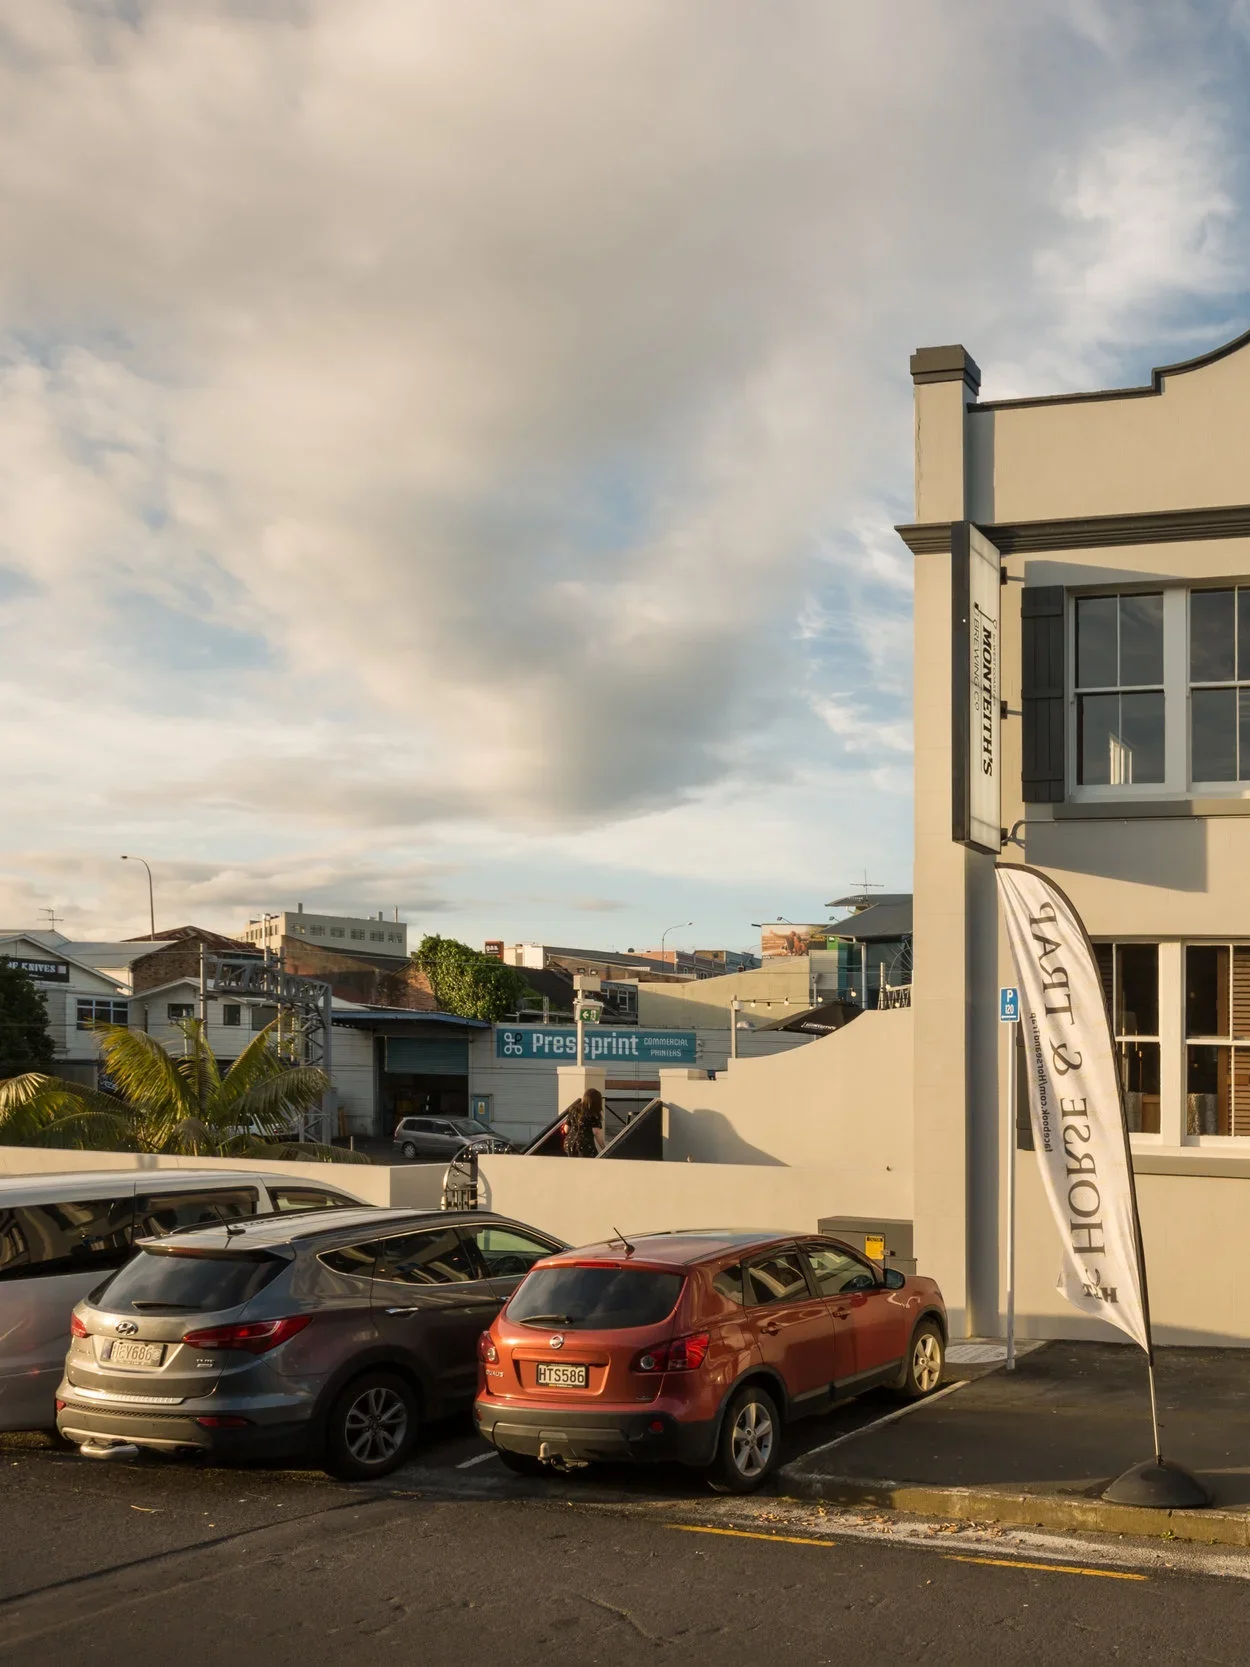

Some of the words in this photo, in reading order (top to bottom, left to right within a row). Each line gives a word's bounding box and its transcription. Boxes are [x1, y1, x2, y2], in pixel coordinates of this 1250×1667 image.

[982, 625, 993, 777] MONTEITH'S
[21, 962, 56, 973] KNIVES
[1006, 989, 1014, 1003] P
[532, 1032, 639, 1060] Pressprint
[643, 1037, 689, 1047] COMMERCIAL
[650, 1048, 682, 1057] PRINTERS
[539, 1368, 584, 1384] HTS586
